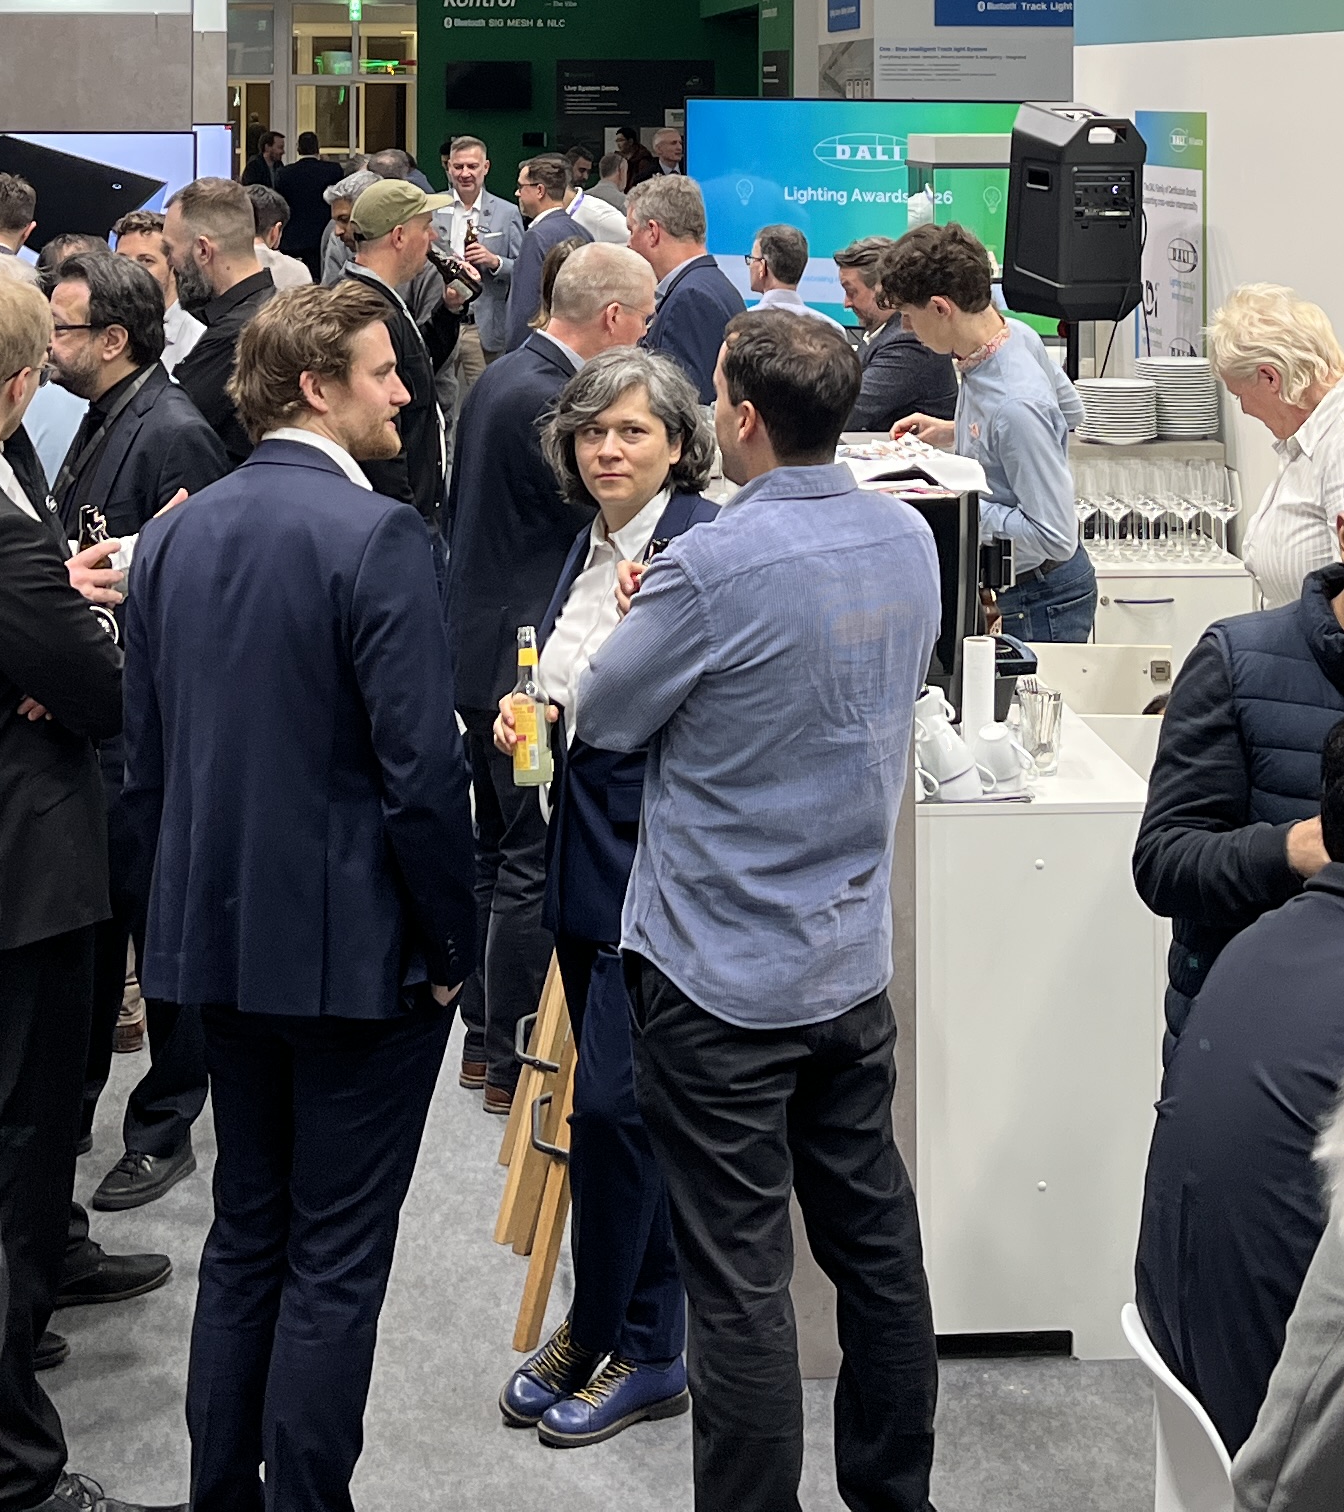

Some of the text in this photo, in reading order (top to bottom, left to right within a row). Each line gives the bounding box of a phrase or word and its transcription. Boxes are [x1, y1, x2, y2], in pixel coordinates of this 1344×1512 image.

[1021, 2, 1047, 10] Track
[489, 19, 504, 27] SIG
[507, 19, 533, 27] MESH
[547, 19, 565, 27] NLC
[836, 146, 900, 161] DALI
[784, 187, 847, 205] Lighting
[934, 193, 953, 204] 26
